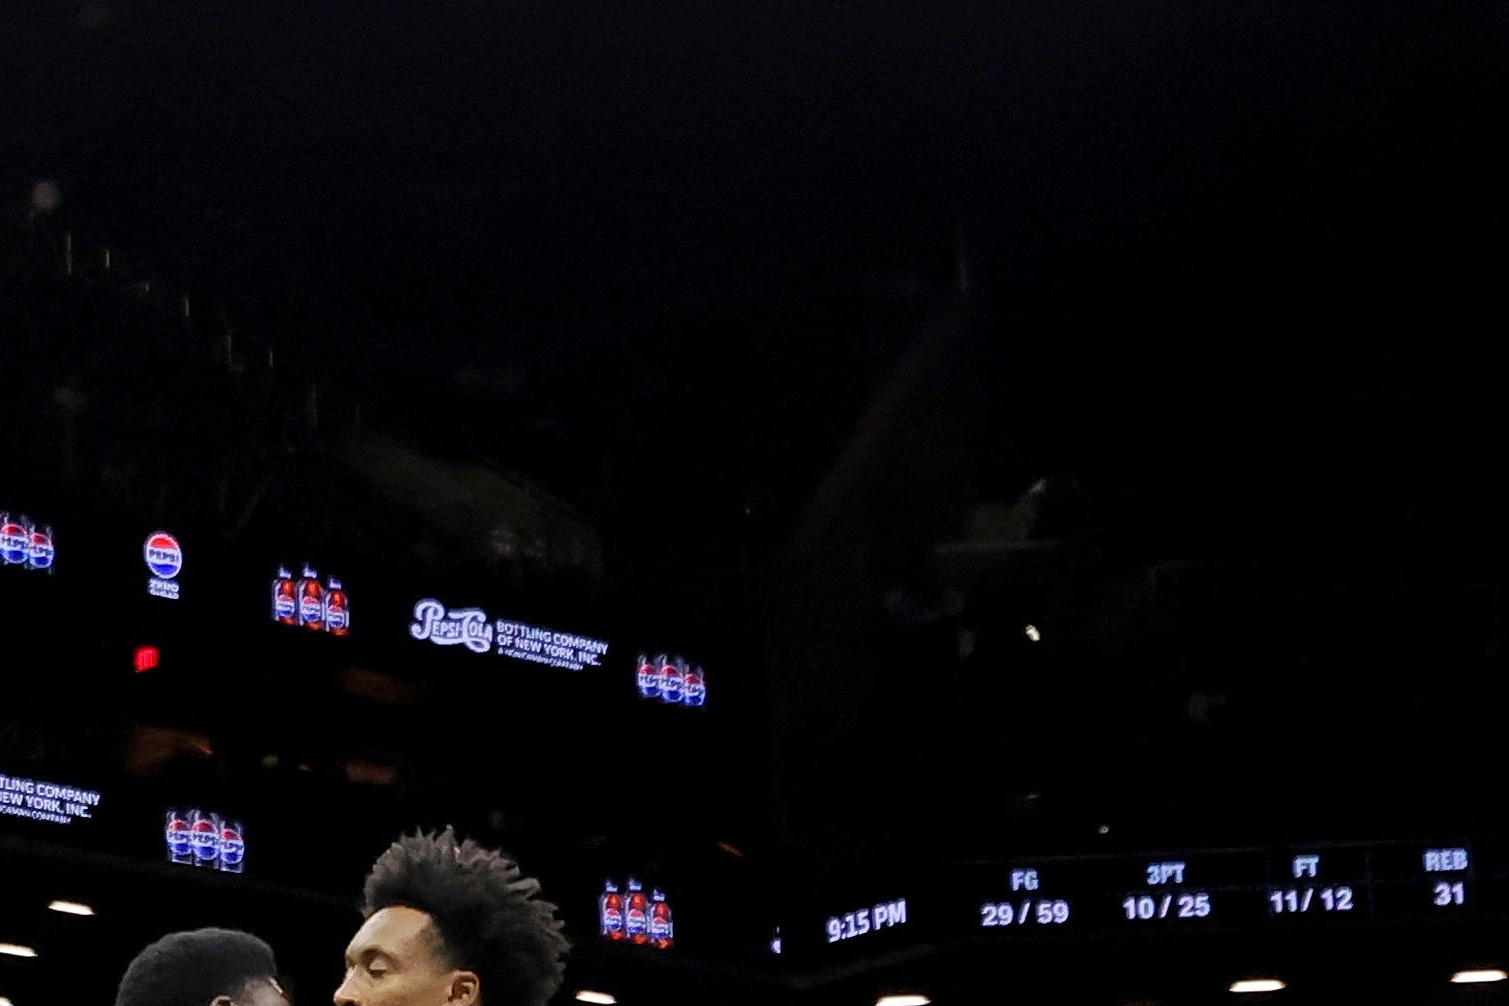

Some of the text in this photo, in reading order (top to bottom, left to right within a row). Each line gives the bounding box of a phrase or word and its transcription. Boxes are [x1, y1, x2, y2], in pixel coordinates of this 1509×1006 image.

[496, 619, 609, 655] BOTTLING COMPANY
[497, 633, 514, 648] OF
[514, 637, 542, 656] NEW
[36, 781, 101, 807] COMPANY
[66, 803, 92, 819] INC.
[1292, 854, 1319, 878] FT
[1422, 847, 1468, 872] REB
[1010, 867, 1039, 891] FG
[1146, 861, 1186, 885] 3PT
[1123, 896, 1155, 920] 10
[1178, 892, 1211, 918] 25
[1269, 889, 1298, 913] 11
[1320, 886, 1354, 912] 12
[1434, 882, 1465, 906] 31
[826, 897, 907, 943] 9:15 PM
[981, 900, 1013, 926] 29
[1035, 899, 1070, 925] 59
